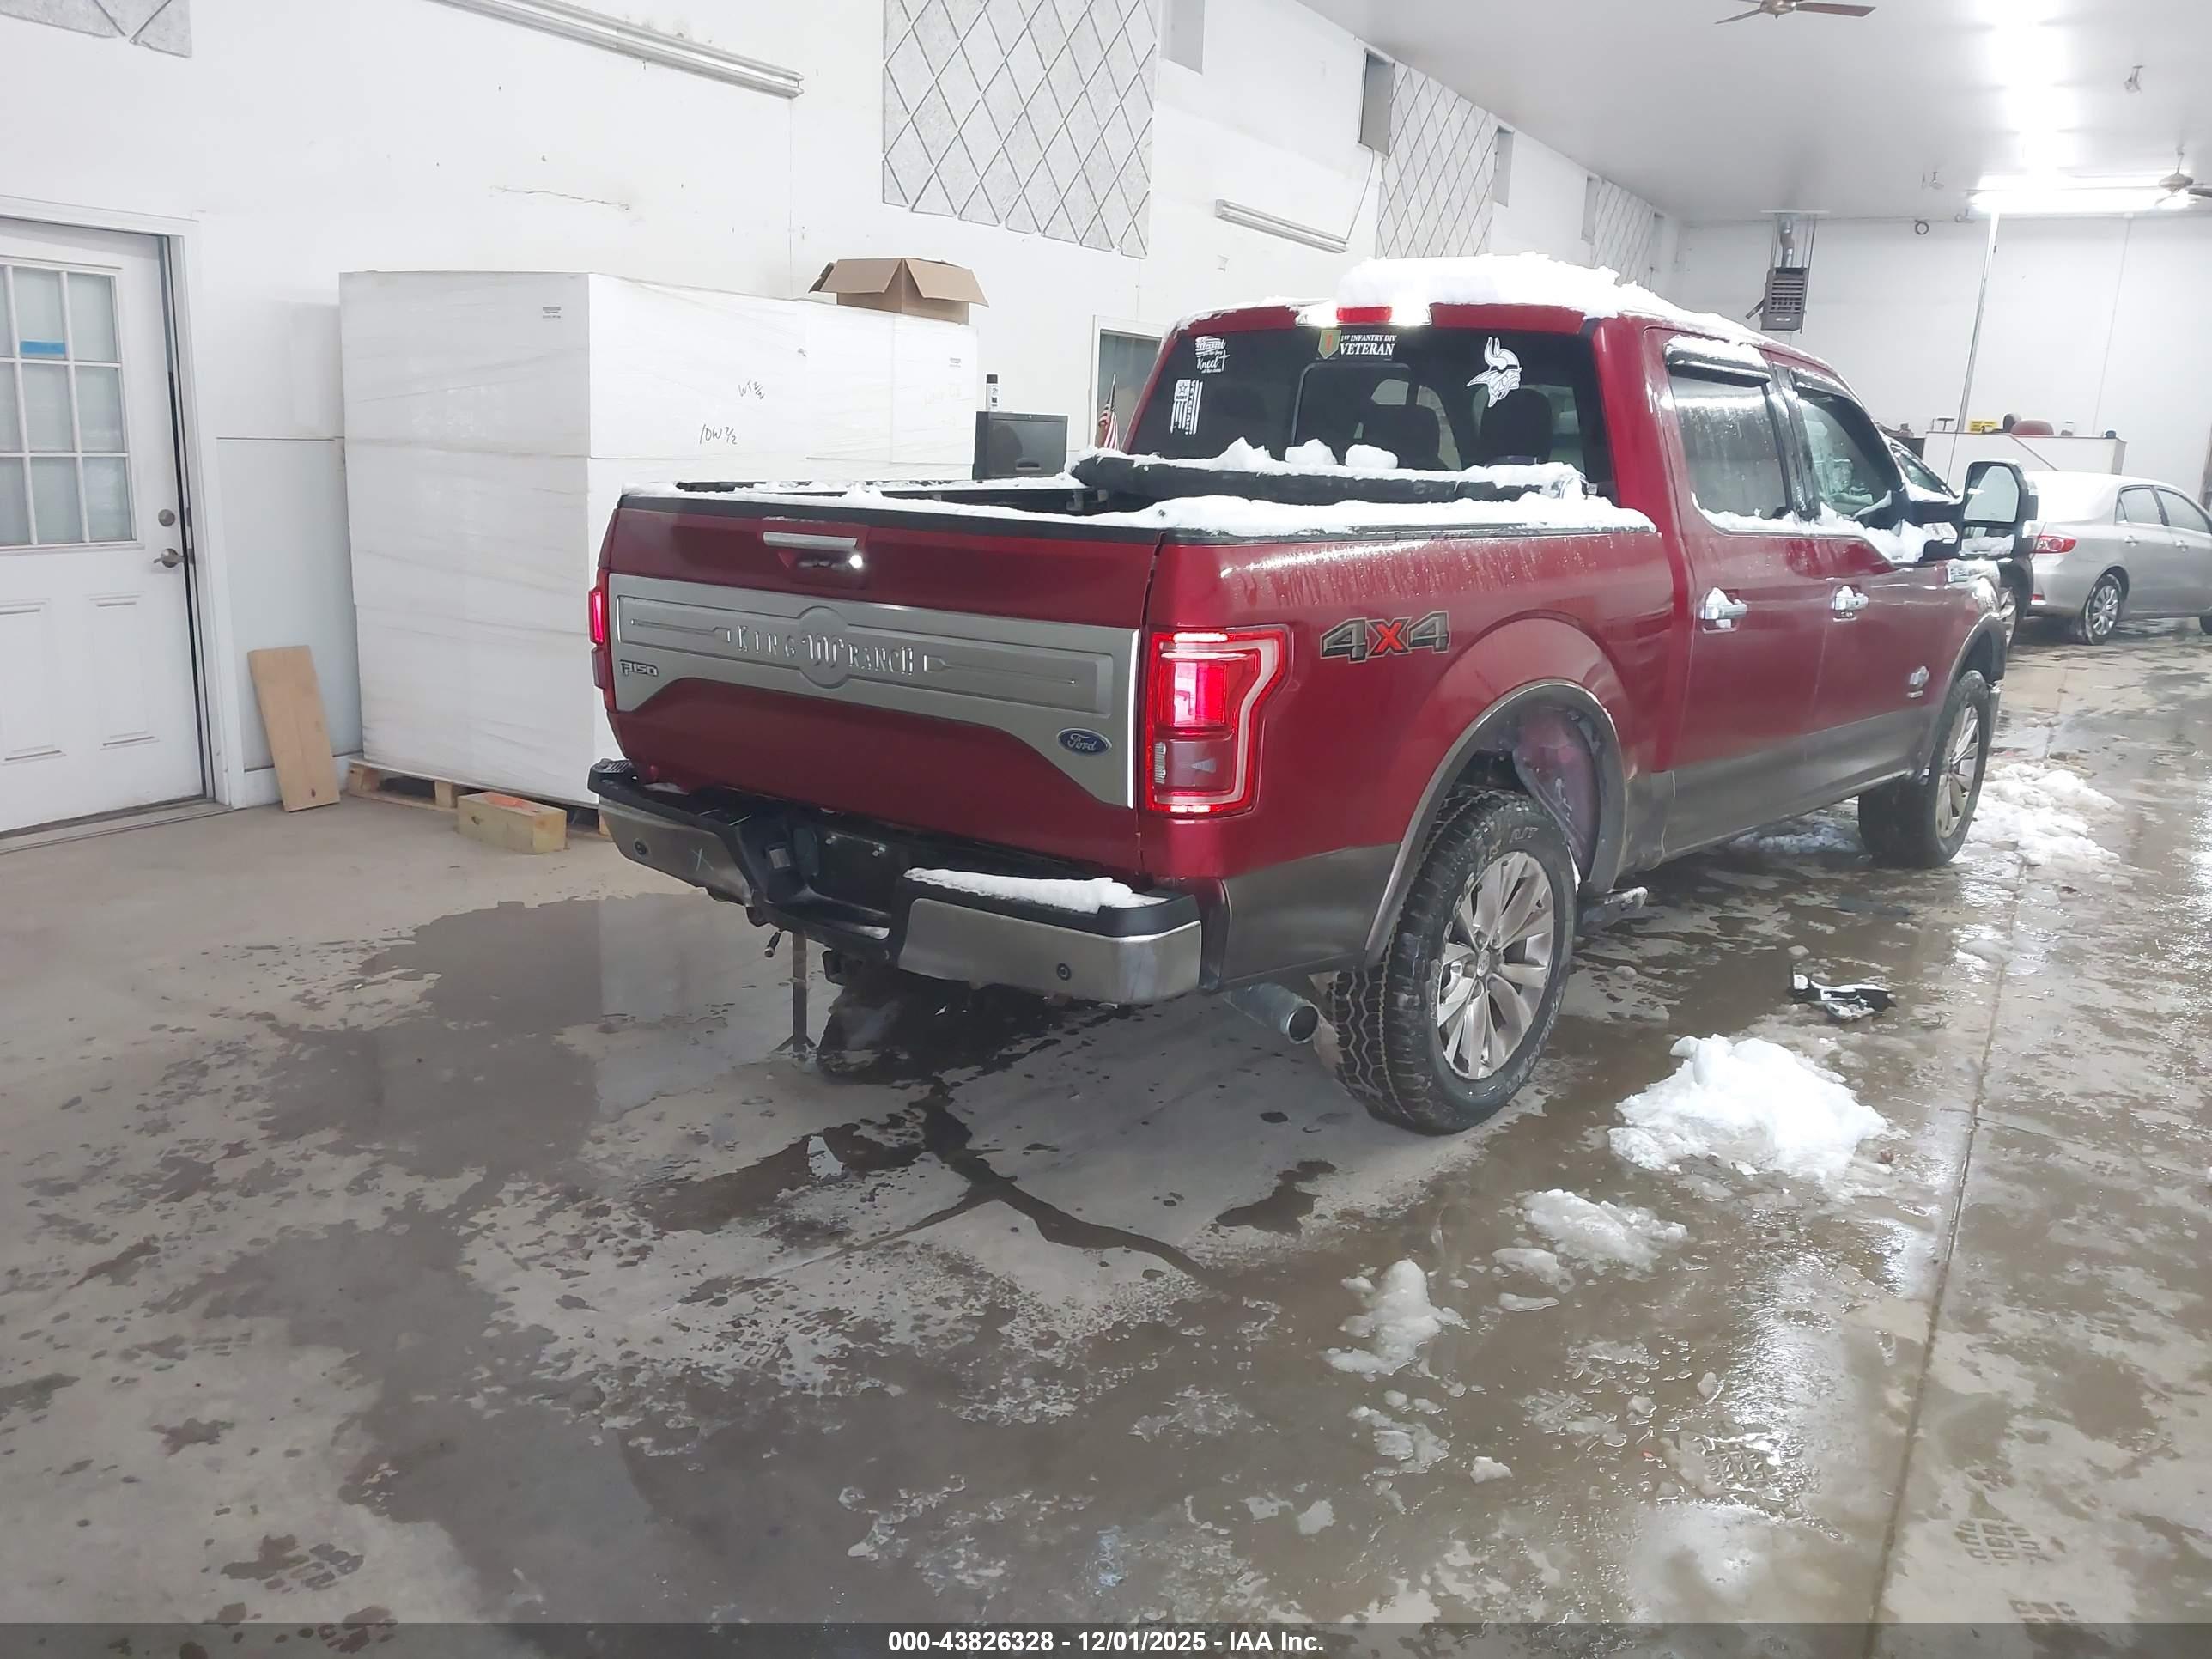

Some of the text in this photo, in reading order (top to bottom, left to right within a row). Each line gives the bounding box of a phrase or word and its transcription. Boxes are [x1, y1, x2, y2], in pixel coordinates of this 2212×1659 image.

[1340, 343, 1395, 356] VETERAN
[1196, 355, 1219, 370] Kneel
[738, 625, 914, 676] KING RANCH
[1067, 733, 1097, 751] Ford
